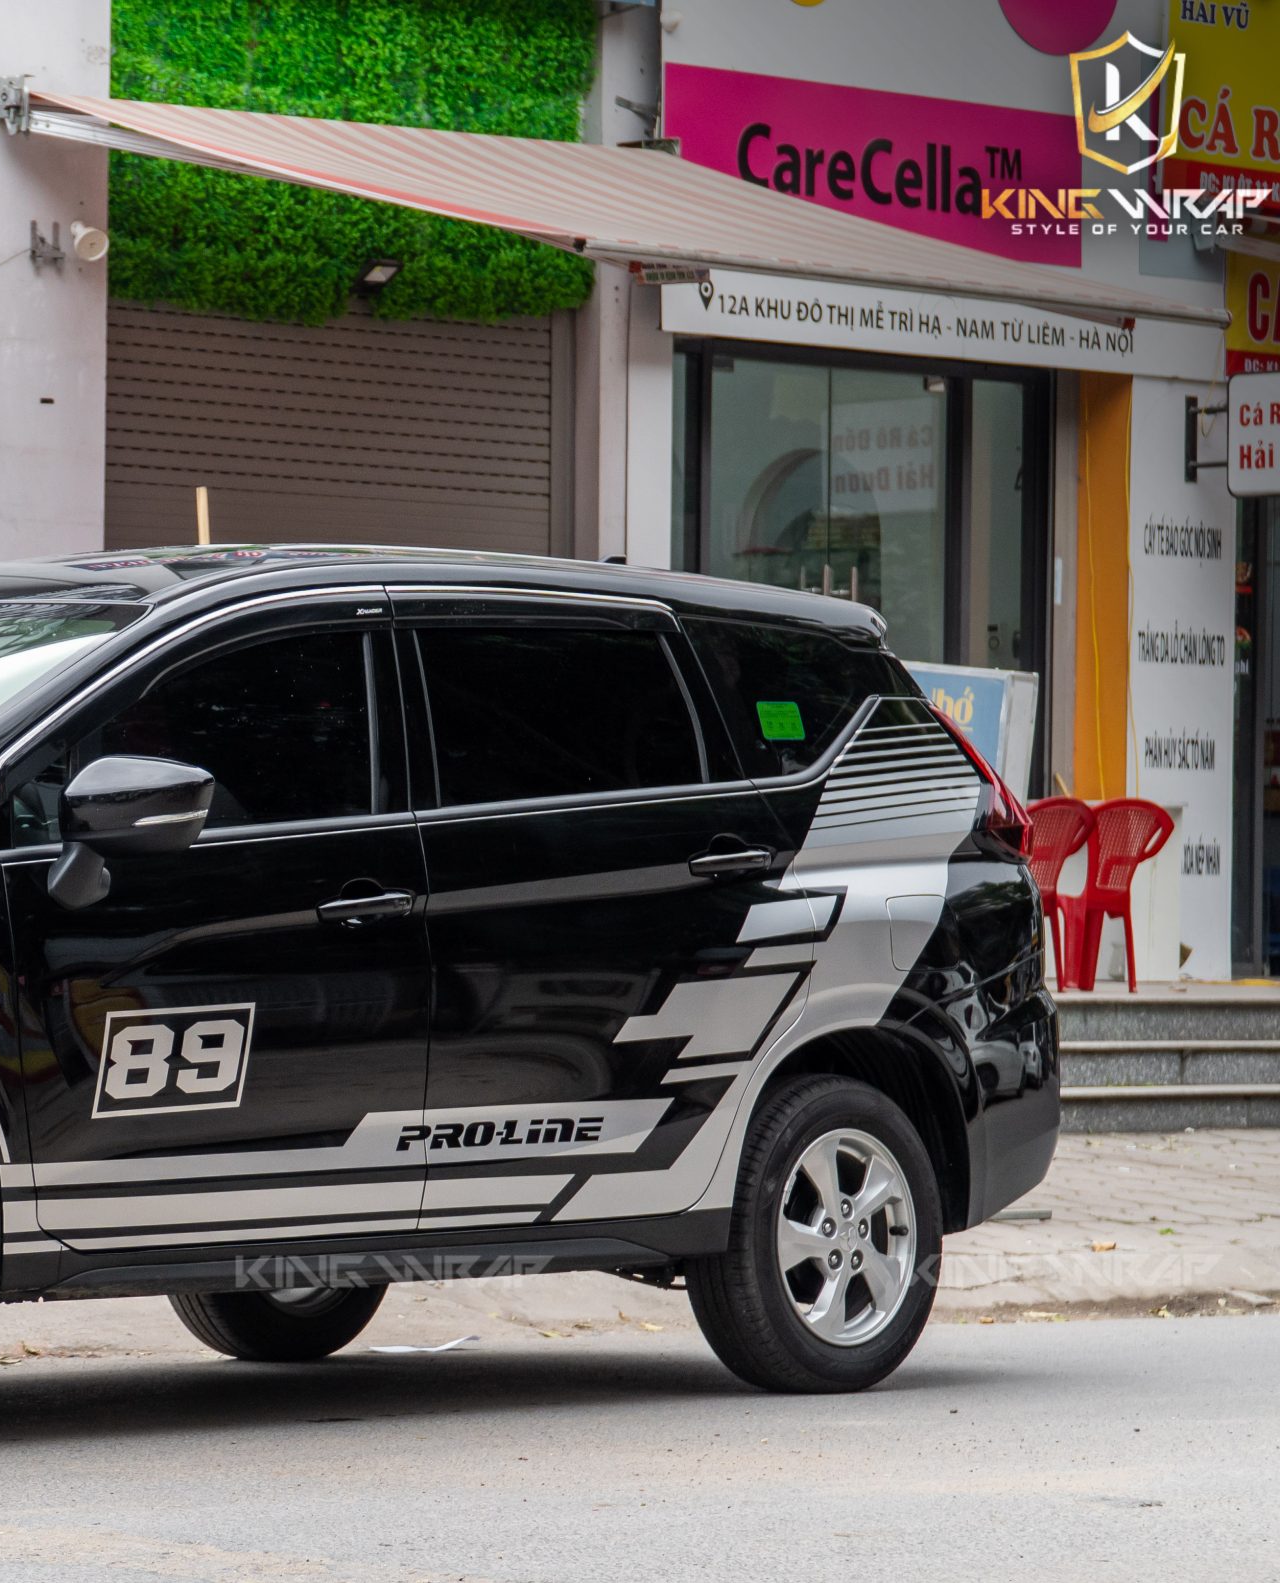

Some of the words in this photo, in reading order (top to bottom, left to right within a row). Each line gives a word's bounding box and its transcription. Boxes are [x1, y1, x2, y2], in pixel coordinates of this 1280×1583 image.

[1222, 2, 1249, 29] VŨ
[1179, 88, 1239, 155] CÁ
[1251, 106, 1280, 161] R
[718, 295, 749, 316] 12A
[755, 297, 791, 320] KHU
[796, 298, 823, 323] ĐÔ
[827, 304, 855, 331] THỊ
[888, 308, 913, 332] TRÌ
[919, 314, 942, 340] HẠ
[956, 317, 994, 340] NAM
[1001, 317, 1024, 343] TỪ
[1027, 321, 1065, 347] LIÊM
[1079, 327, 1101, 350] HÀ
[1106, 330, 1133, 357] NỘI
[1239, 402, 1263, 426] Cá
[1239, 440, 1274, 470] Hải
[1207, 527, 1222, 560] SINH
[1160, 631, 1169, 663] DA
[1217, 634, 1225, 666] TO
[931, 686, 975, 724] hớ
[105, 1019, 245, 1099] 89
